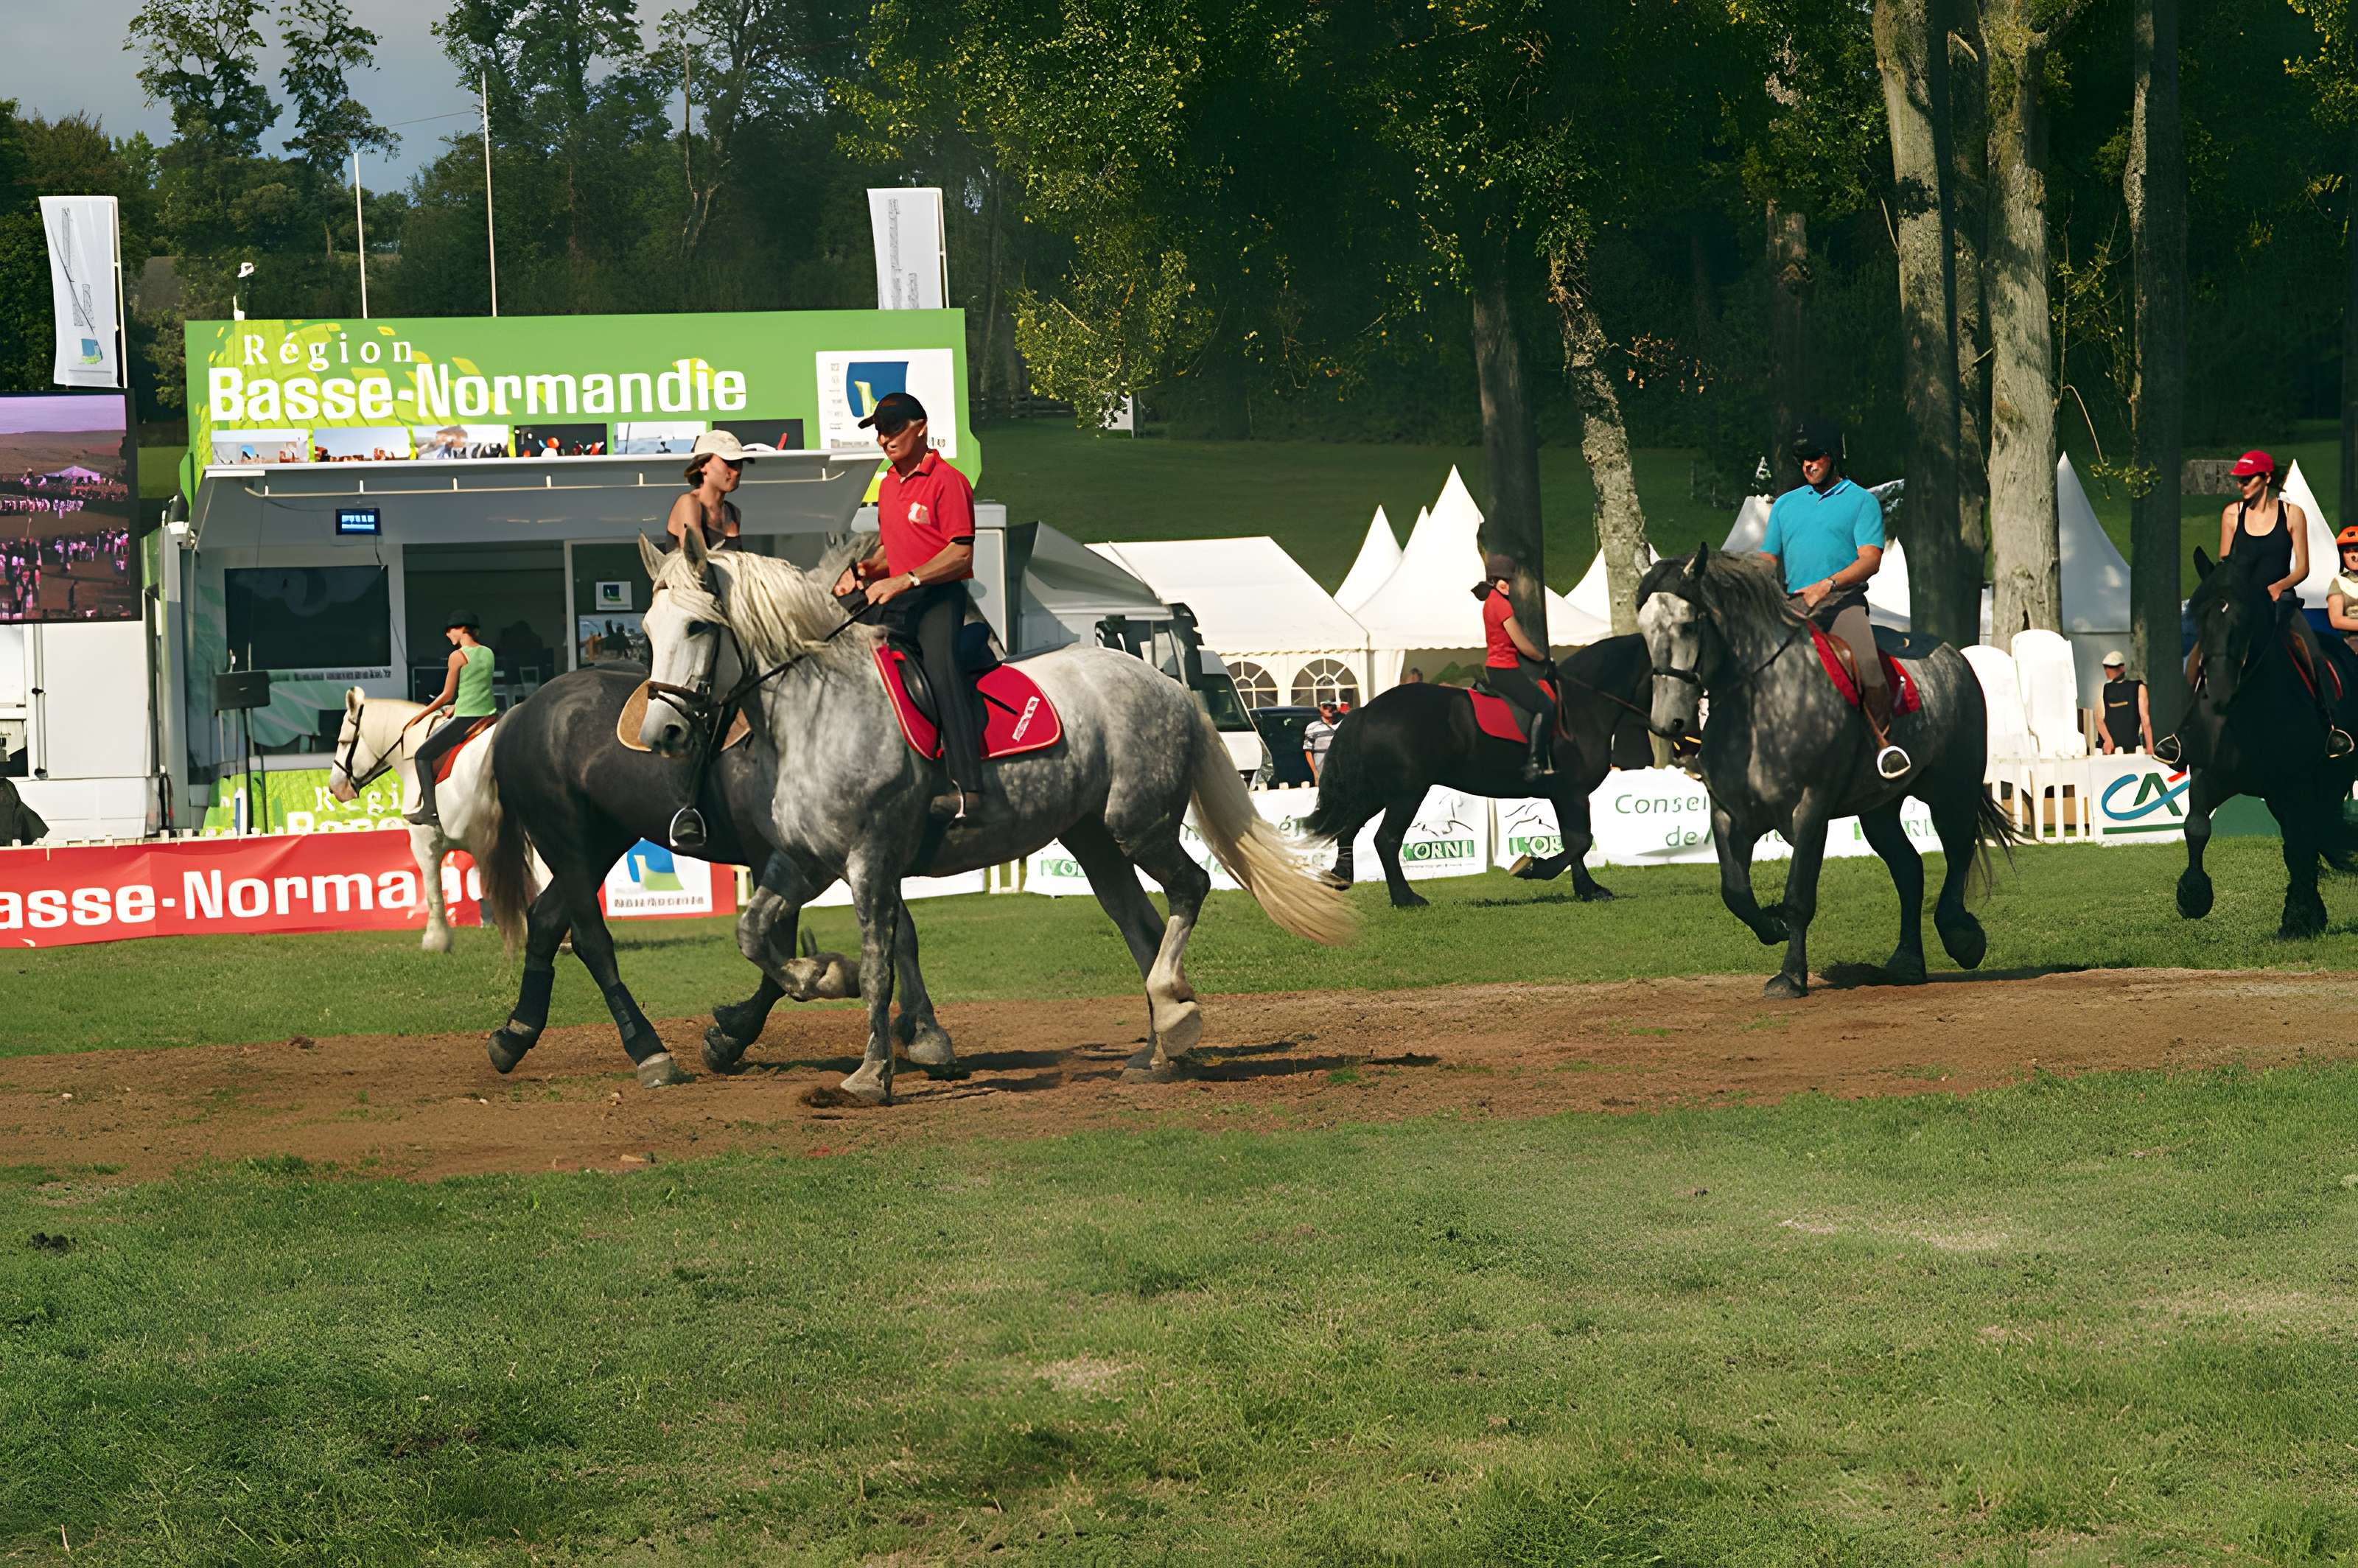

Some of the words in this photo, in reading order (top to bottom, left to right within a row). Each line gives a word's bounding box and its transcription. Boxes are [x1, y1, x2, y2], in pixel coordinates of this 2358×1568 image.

[242, 332, 413, 371] Région
[209, 358, 747, 421] Basse-Normandie
[1615, 794, 1707, 814] Consei
